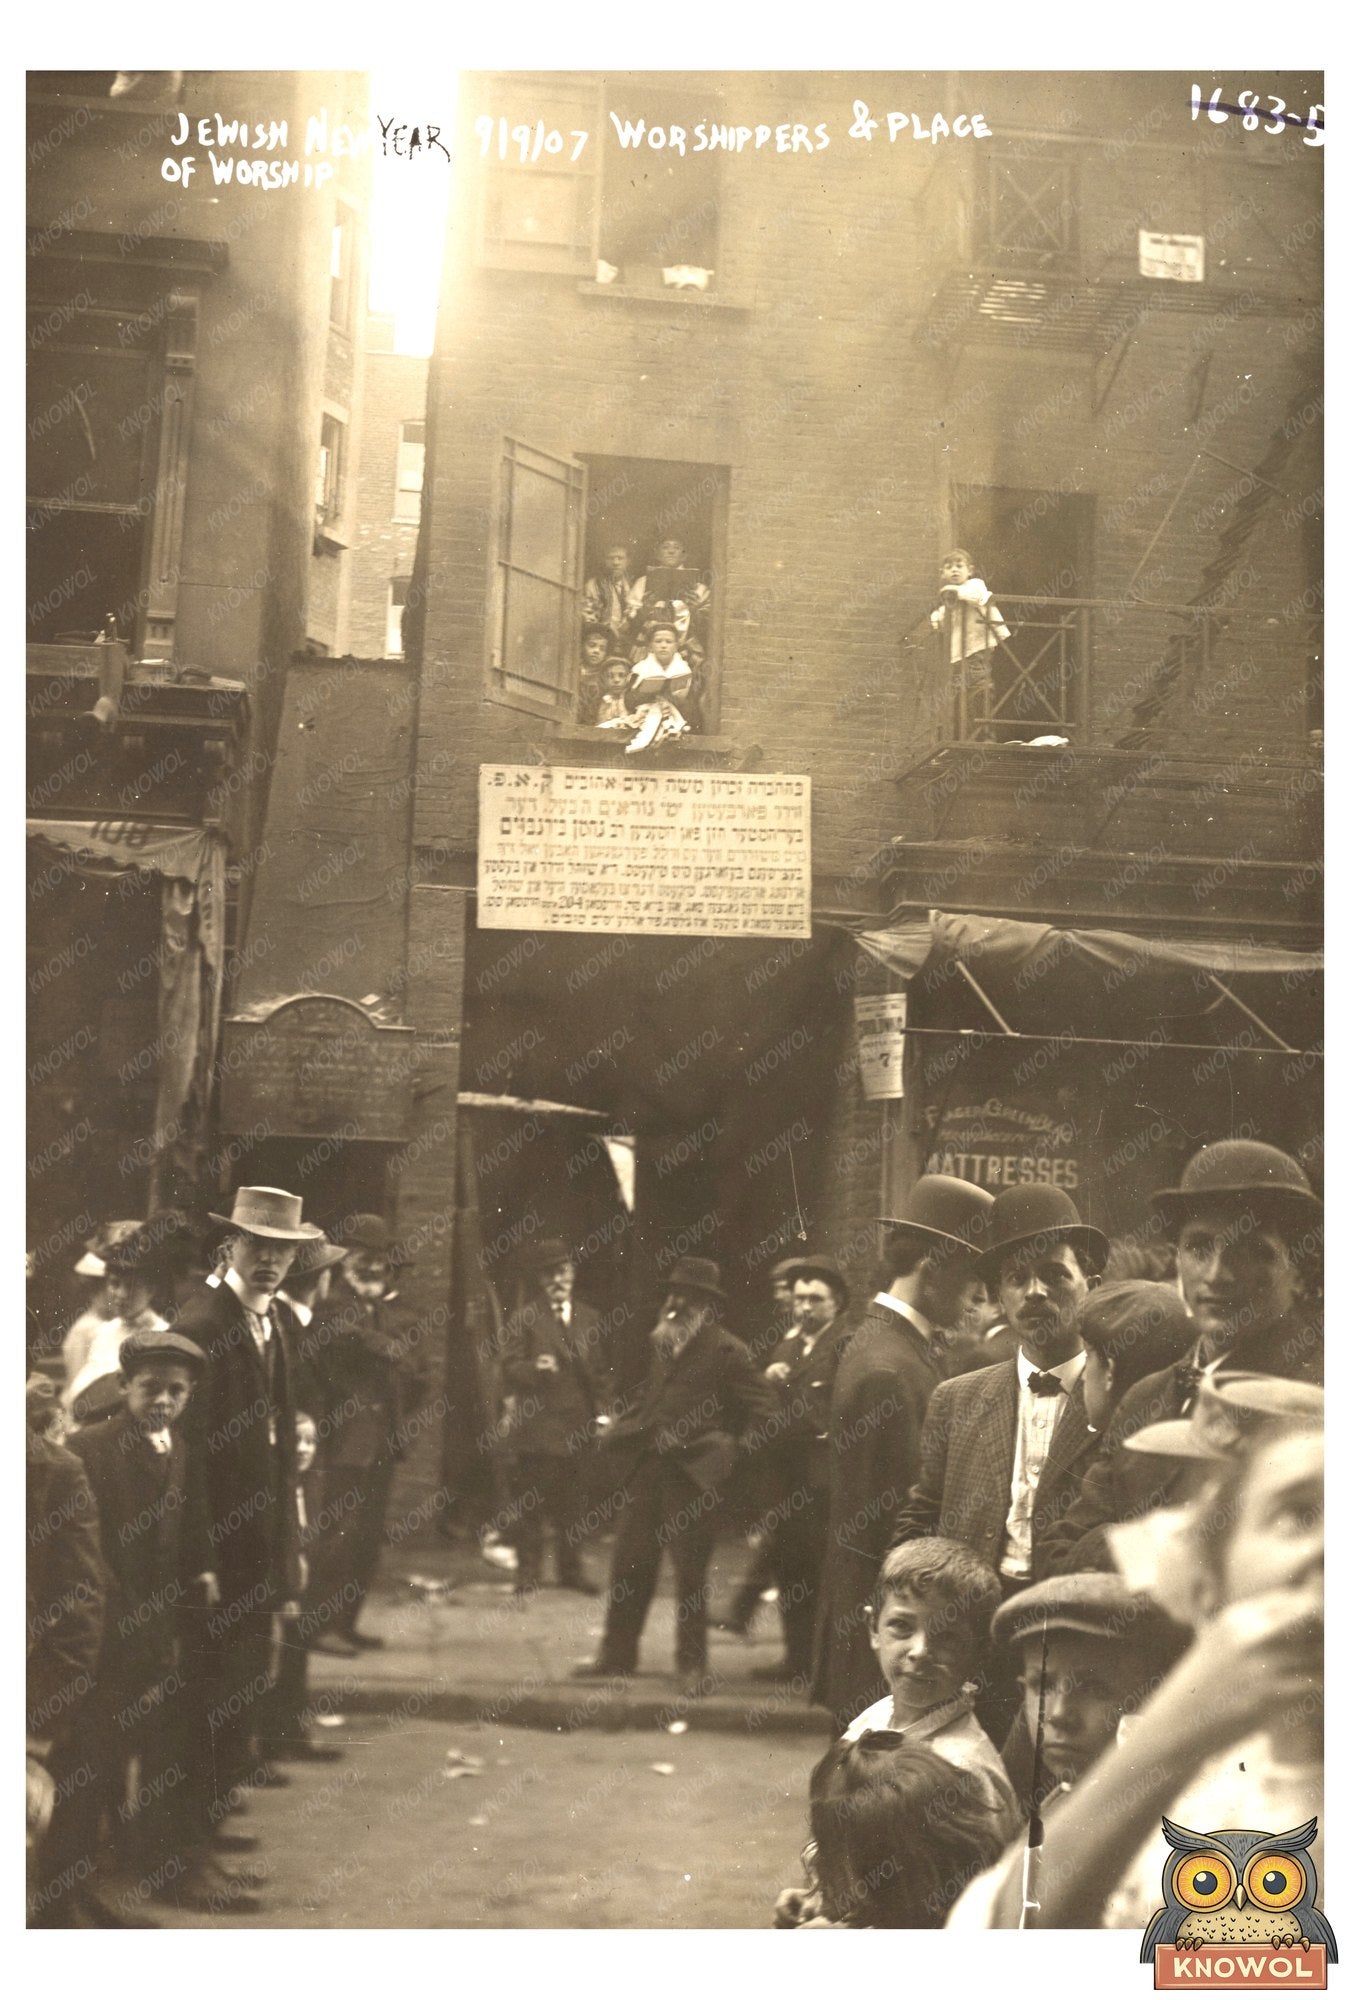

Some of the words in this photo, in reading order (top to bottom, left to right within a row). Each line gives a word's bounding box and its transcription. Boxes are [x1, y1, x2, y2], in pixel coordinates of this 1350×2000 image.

[171, 113, 288, 148] JEWISH
[377, 113, 450, 162] YEAR
[476, 112, 589, 161] 9/9/07
[610, 111, 829, 156] WORSHIPPERS
[848, 101, 878, 141] &
[887, 112, 993, 147] PLACE
[161, 156, 196, 188] OF
[208, 151, 334, 191] WORSHIP
